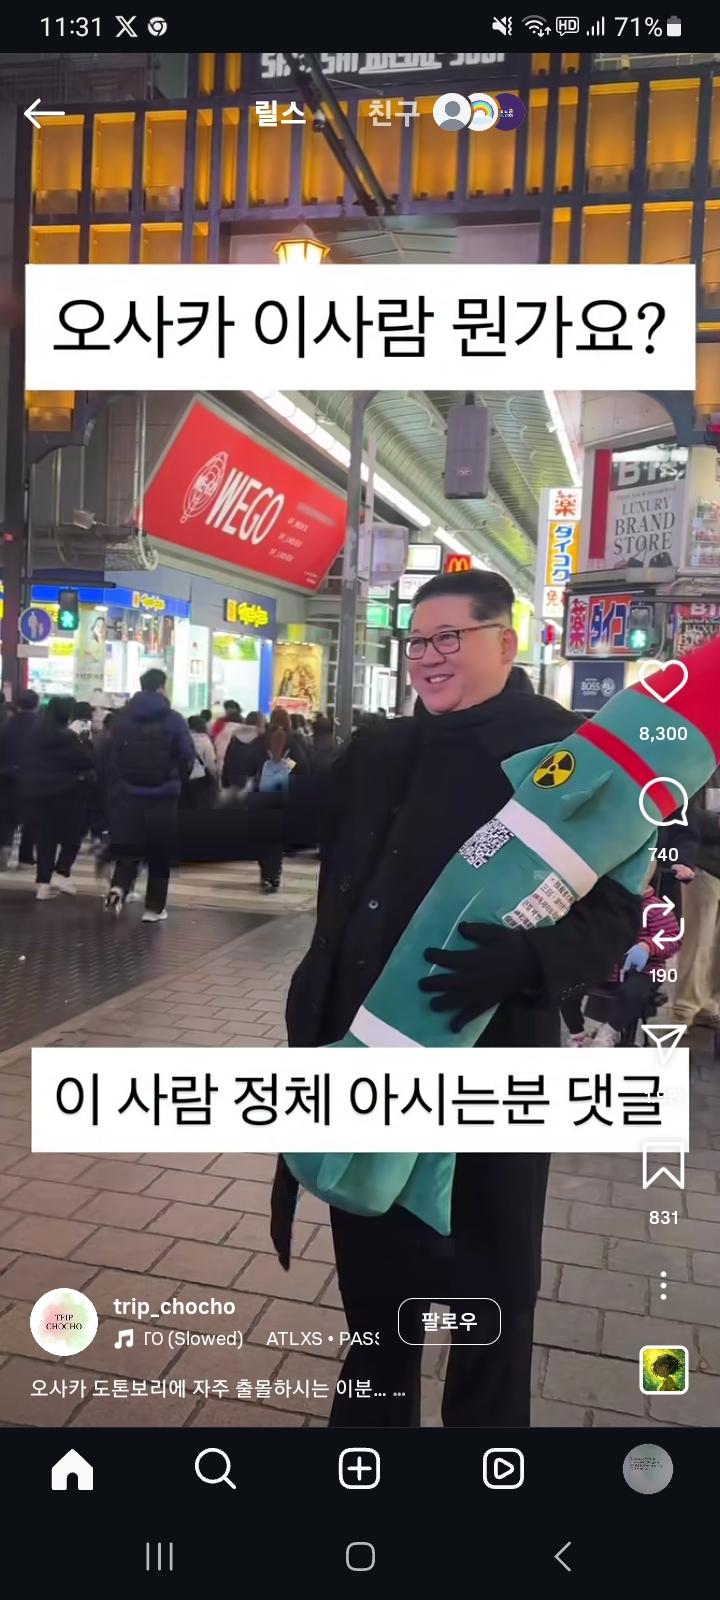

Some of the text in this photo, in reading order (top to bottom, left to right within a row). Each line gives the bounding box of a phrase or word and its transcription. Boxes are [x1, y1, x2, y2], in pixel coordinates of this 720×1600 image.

[205, 468, 284, 545] WEGO
[622, 497, 670, 515] LUXURY
[615, 512, 675, 536] BRAND
[614, 532, 672, 555] STORE
